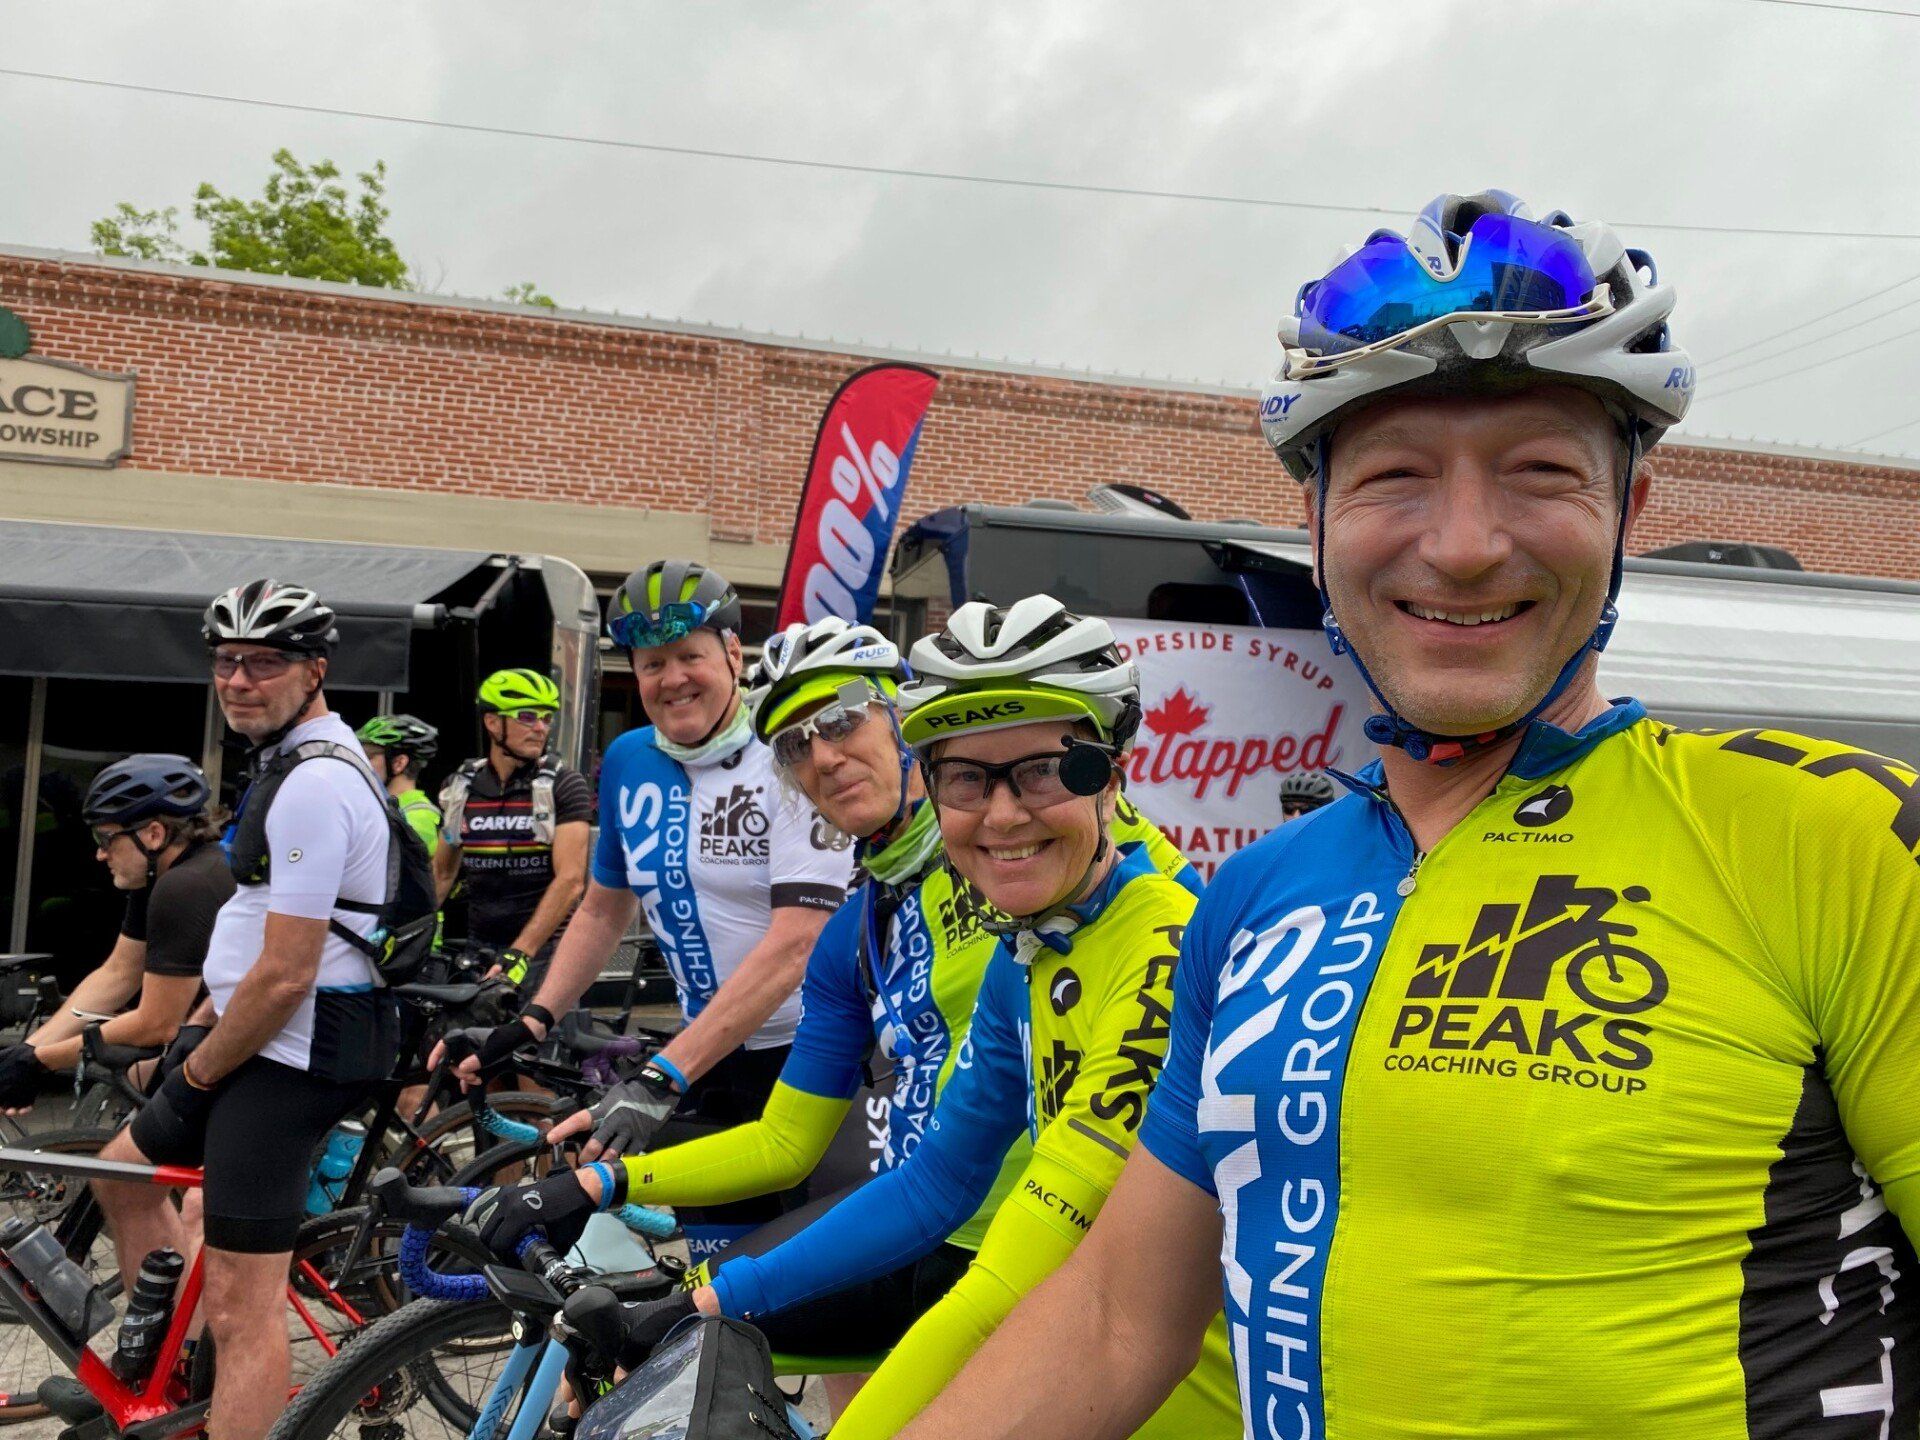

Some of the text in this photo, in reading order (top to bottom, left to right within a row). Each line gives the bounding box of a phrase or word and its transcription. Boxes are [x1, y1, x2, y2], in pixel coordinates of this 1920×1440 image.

[853, 646, 891, 661] RUDY
[1248, 638, 1335, 691] SYRUP
[925, 700, 1026, 729] PEAKS
[664, 785, 691, 891] GROUP
[700, 838, 770, 857] PEAKS
[1158, 825, 1274, 852] NATU
[1482, 831, 1575, 844] PACTIMO
[700, 856, 740, 866] COACHING
[799, 896, 840, 908] PACTIMO
[1277, 891, 1386, 1146] GROUP
[1388, 1004, 1654, 1071] PEAKS
[1383, 1054, 1648, 1096] COACHING GROUP
